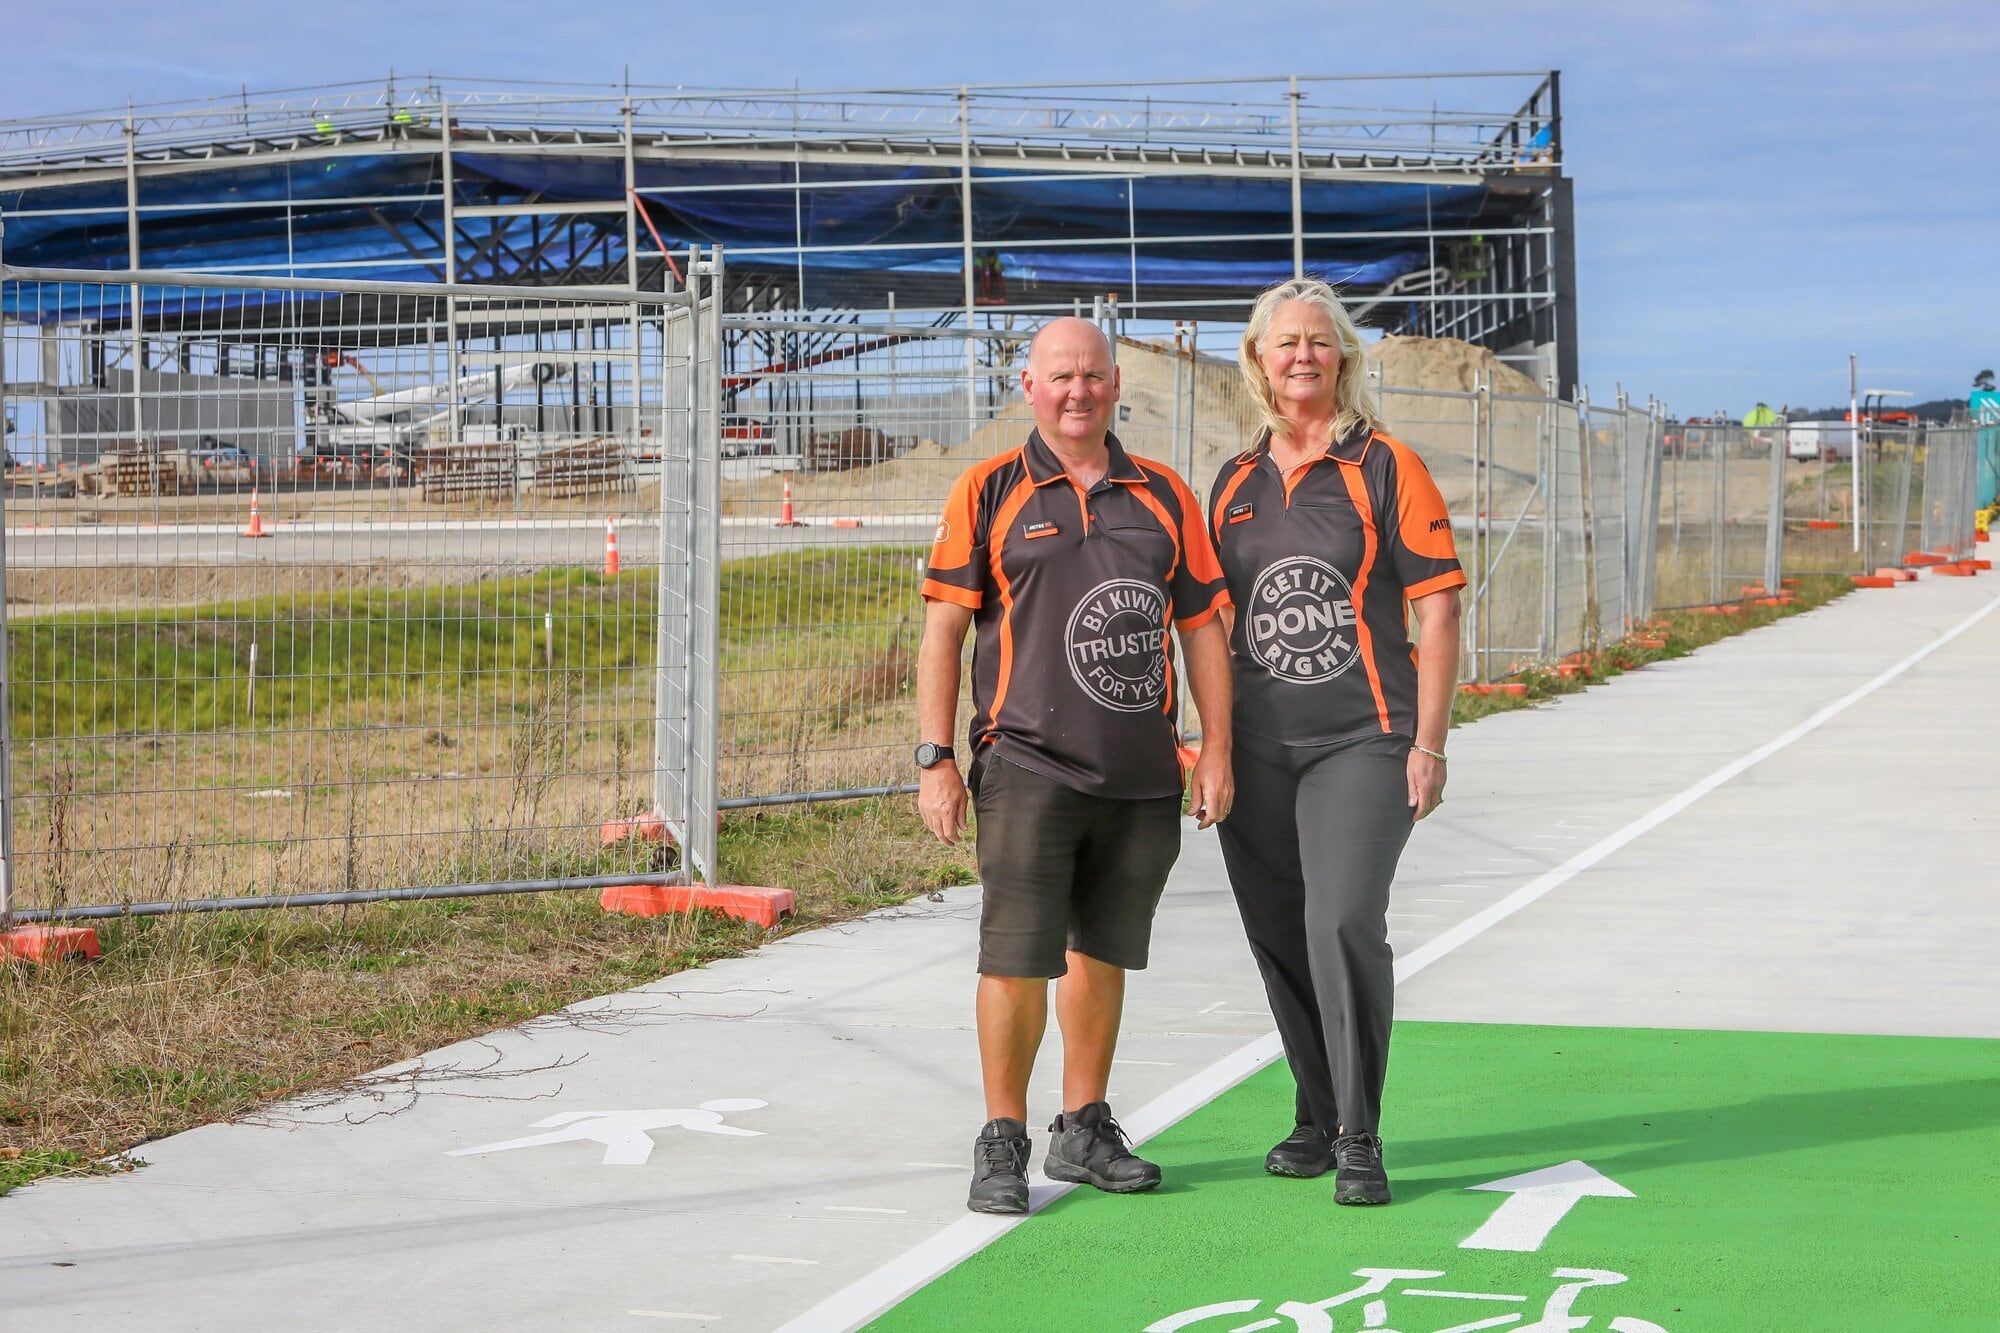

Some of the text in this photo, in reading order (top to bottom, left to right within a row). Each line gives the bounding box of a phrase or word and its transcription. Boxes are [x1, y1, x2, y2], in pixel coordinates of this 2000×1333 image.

[1261, 569, 1335, 603] GET IT
[1081, 590, 1161, 632] BY KIWIS
[1253, 599, 1357, 642] DONE
[1264, 633, 1352, 675] RIGHT
[1088, 665, 1126, 699] FOR
